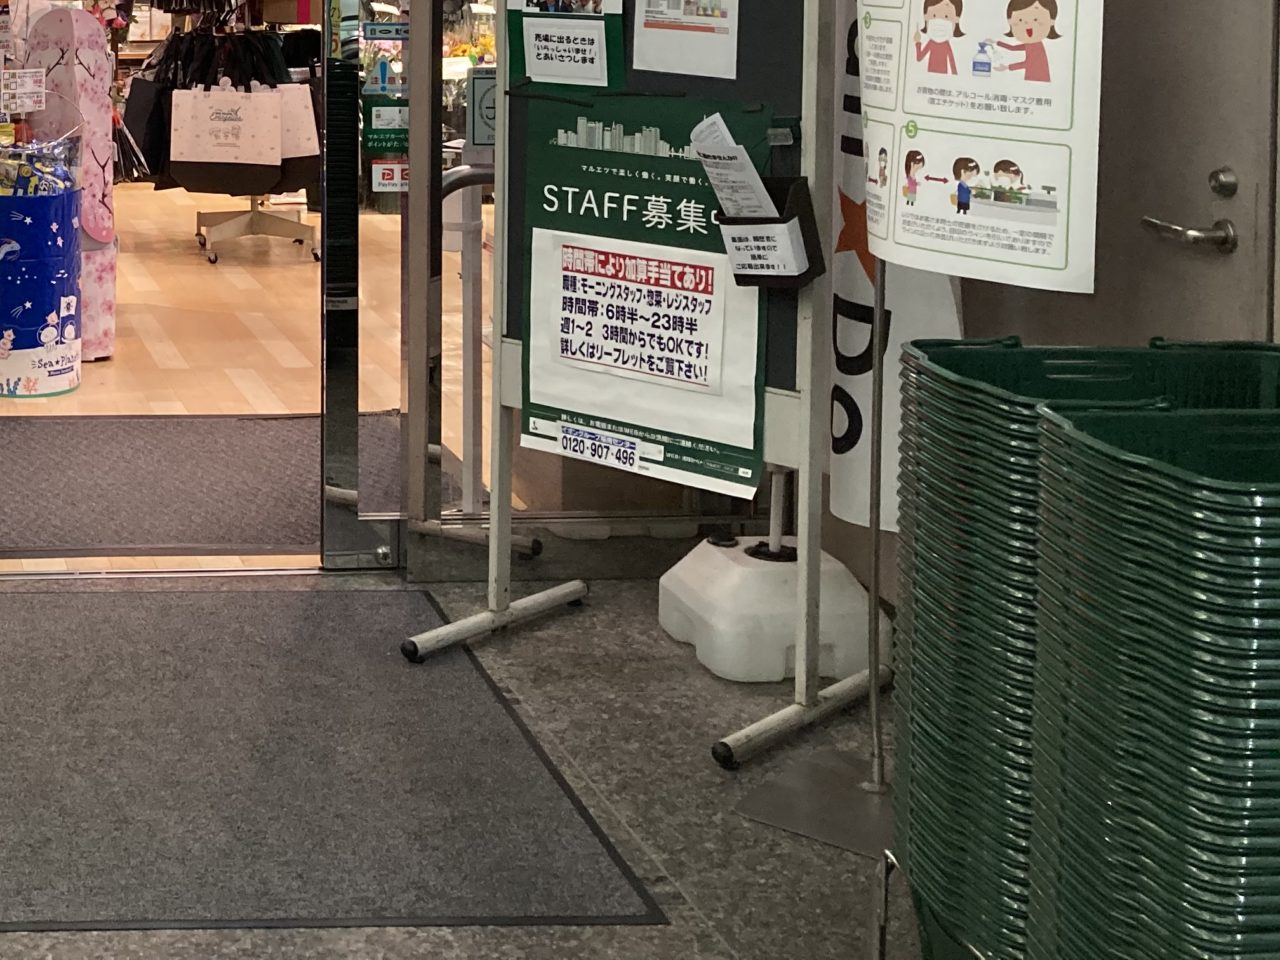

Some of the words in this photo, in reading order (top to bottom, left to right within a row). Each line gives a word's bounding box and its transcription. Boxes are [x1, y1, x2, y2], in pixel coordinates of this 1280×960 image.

[562, 246, 713, 292] 時間帯により加算手当てあり!
[560, 338, 708, 382] 詳しくはリーフレットをご覧下さい!
[602, 324, 709, 360] 3時間からでもOKです!
